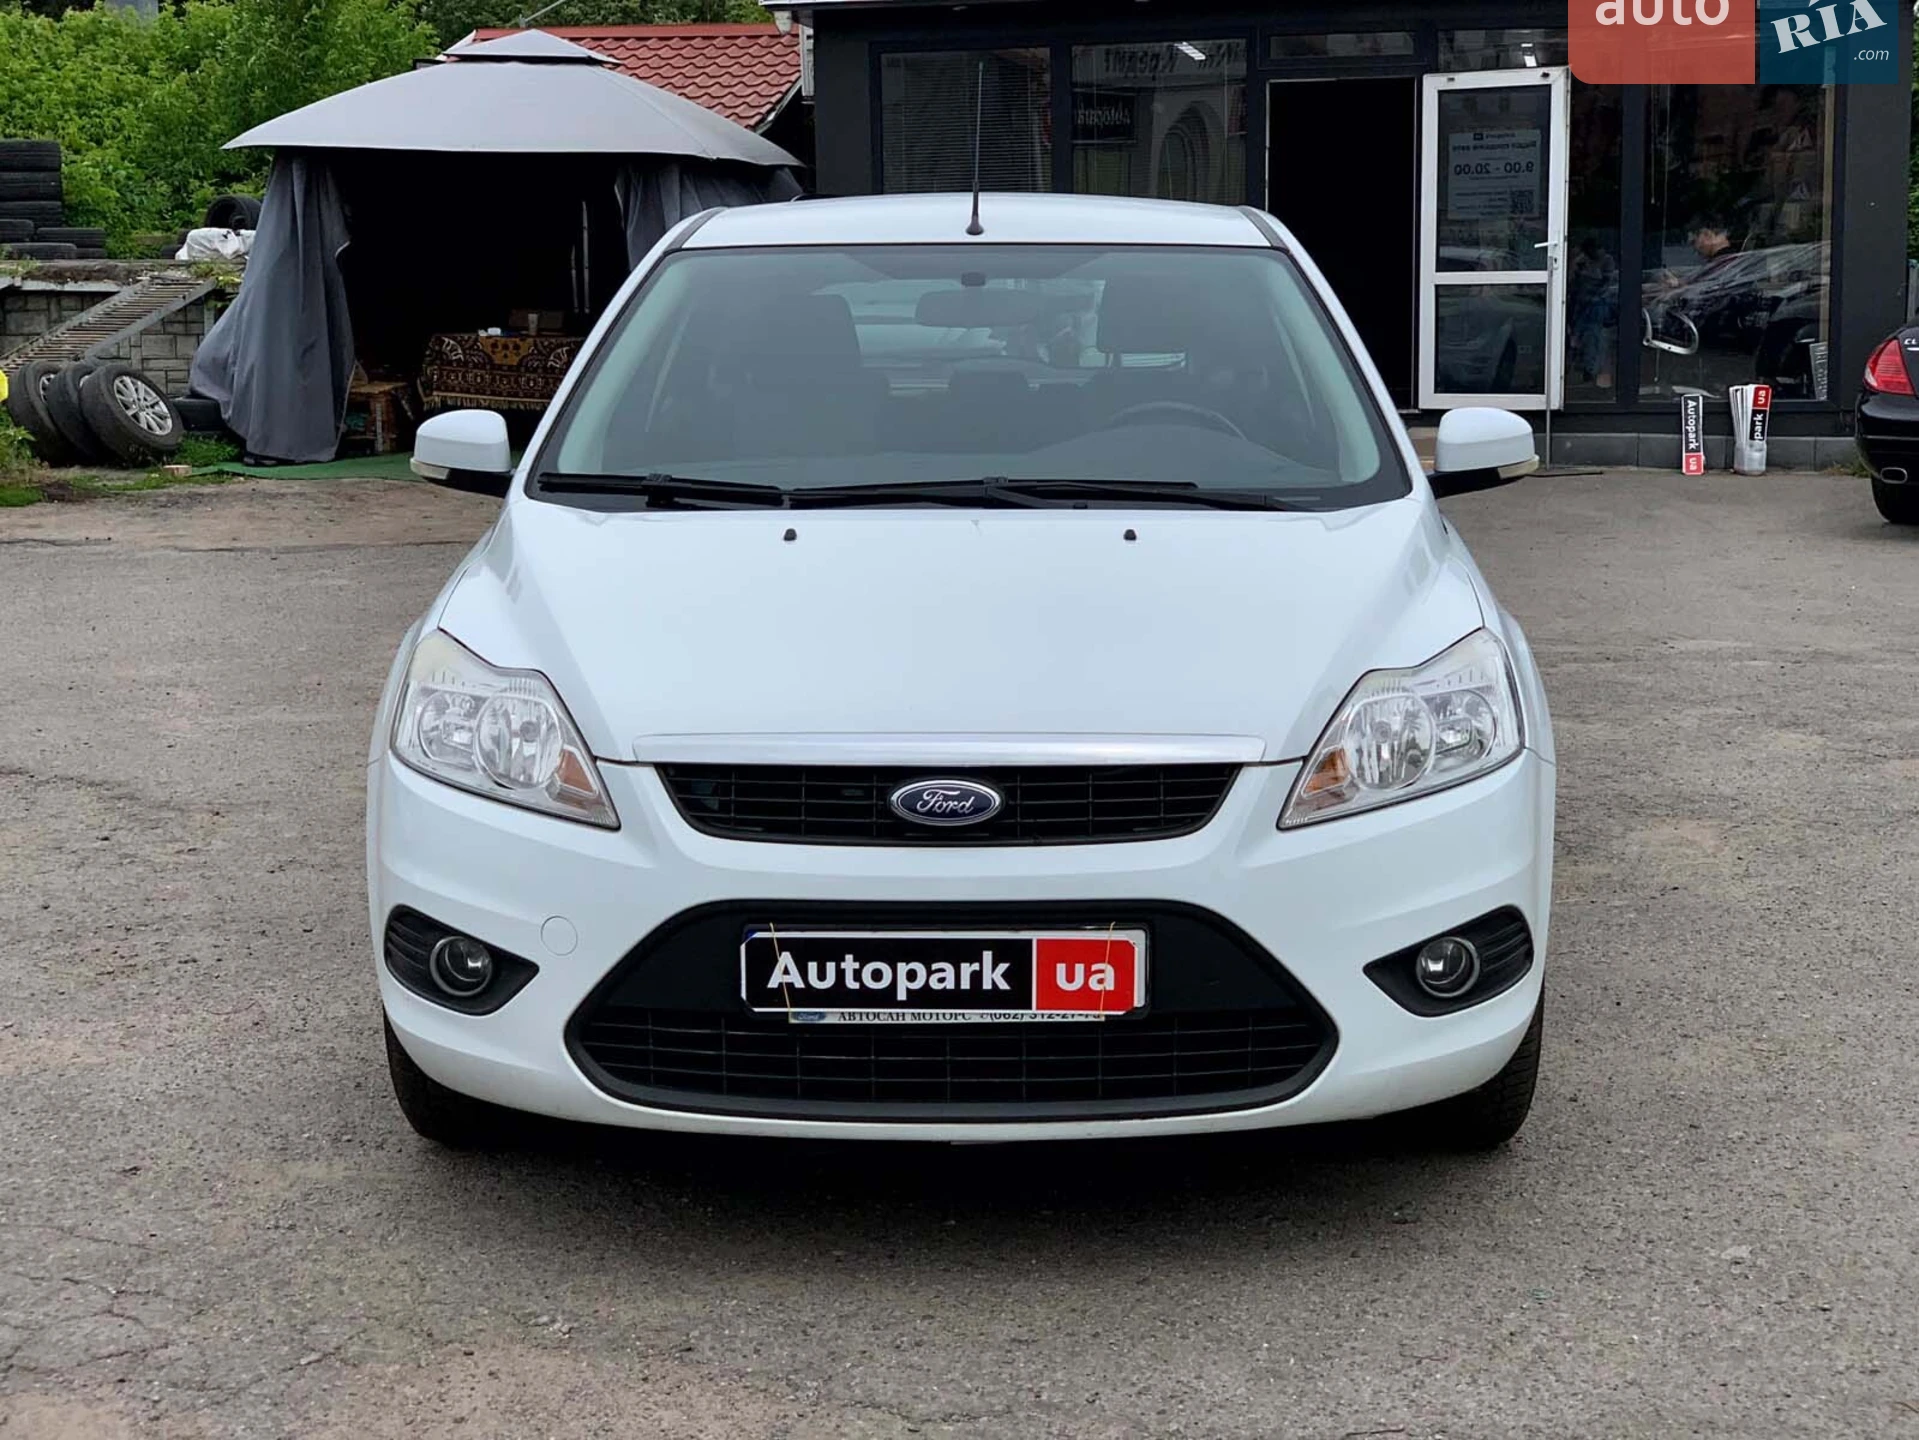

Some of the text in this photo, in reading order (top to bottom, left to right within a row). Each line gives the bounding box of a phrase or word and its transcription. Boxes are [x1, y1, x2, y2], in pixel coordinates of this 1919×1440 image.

[1685, 400, 1700, 471] Autopark ua
[1753, 390, 1767, 441] park ua
[917, 788, 976, 814] Ford
[767, 950, 1116, 1001] Autopark ua
